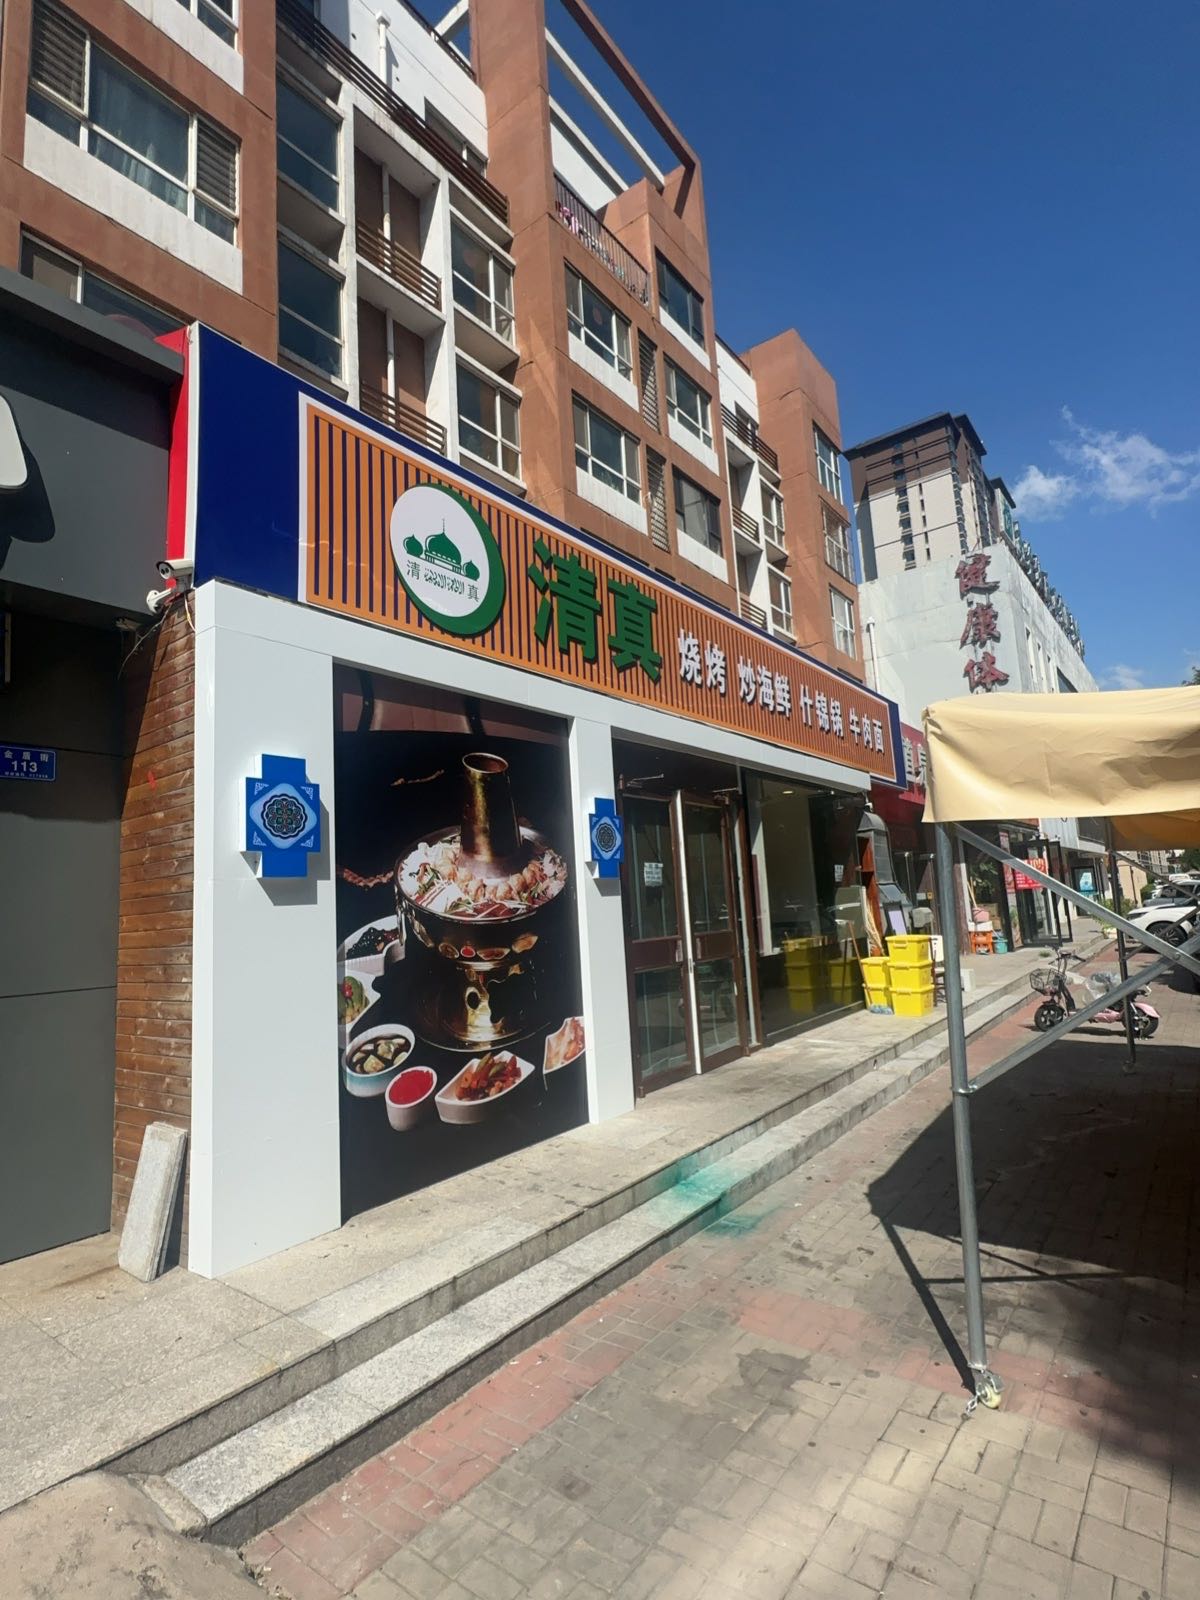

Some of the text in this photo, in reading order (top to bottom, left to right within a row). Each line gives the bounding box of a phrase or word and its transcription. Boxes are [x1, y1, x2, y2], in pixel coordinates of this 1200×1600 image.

[406, 560, 479, 602] 清 真
[528, 537, 662, 683] 清真
[678, 628, 727, 695] 烧烤
[737, 655, 792, 718] 炒海鲜
[800, 683, 845, 739] 什锦锅
[849, 707, 885, 755] 牛肉面
[11, 760, 38, 772] 113
